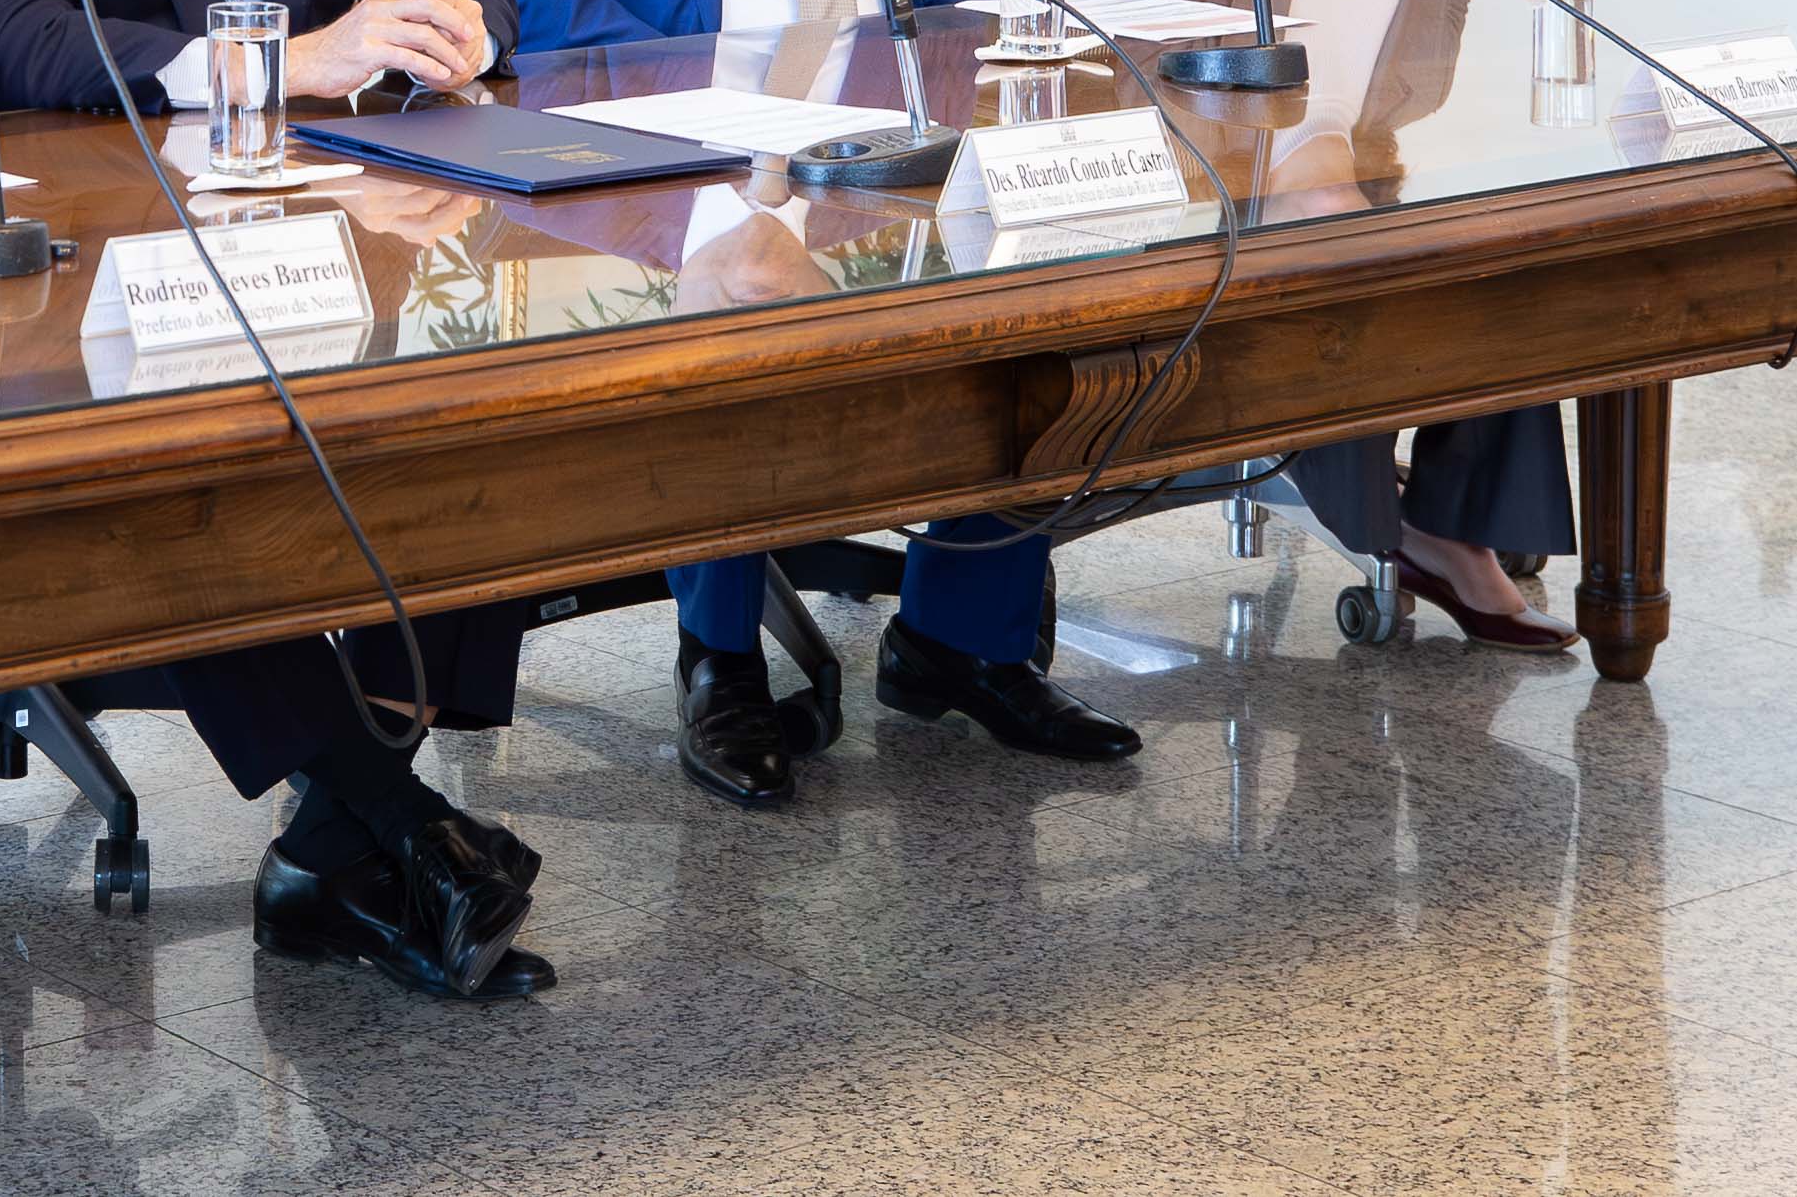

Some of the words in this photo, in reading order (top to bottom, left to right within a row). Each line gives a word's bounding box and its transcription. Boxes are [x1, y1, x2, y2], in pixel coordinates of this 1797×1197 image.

[1693, 83, 1738, 107] erson
[1735, 76, 1780, 98] Barroso
[1777, 70, 1797, 92] Sim
[986, 168, 1018, 193] Des.
[1017, 160, 1070, 189] Ricardo
[1070, 157, 1110, 182] Couto
[1111, 152, 1128, 176] de
[1127, 149, 1171, 175] Castro
[126, 278, 208, 306] Rodrigo
[216, 271, 271, 294] eves
[274, 261, 349, 288] Barreto
[135, 312, 193, 336] Prefeito
[195, 308, 214, 329] do
[291, 296, 310, 315] de
